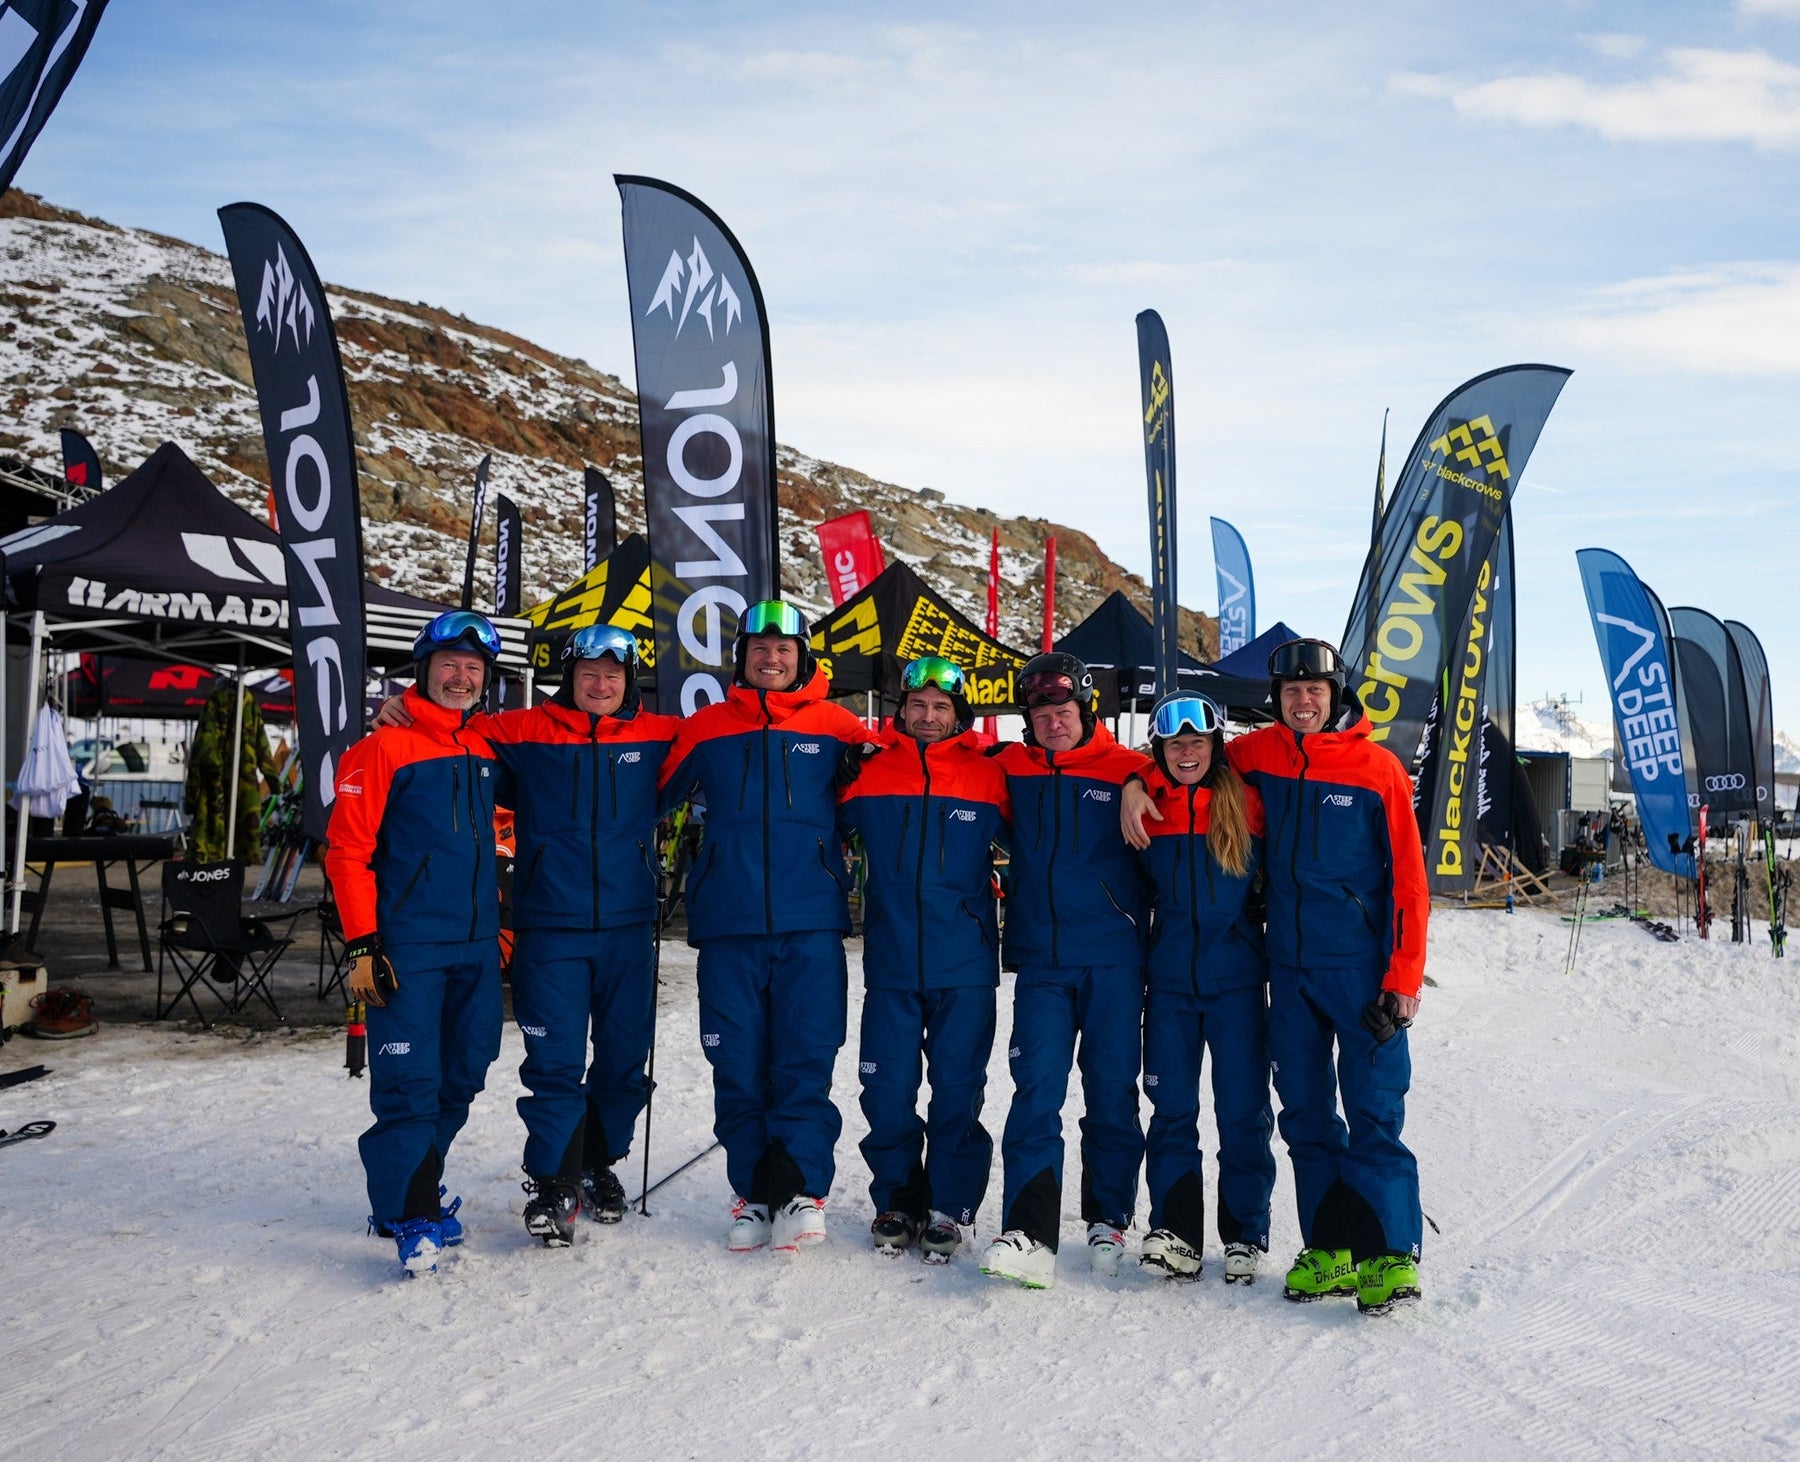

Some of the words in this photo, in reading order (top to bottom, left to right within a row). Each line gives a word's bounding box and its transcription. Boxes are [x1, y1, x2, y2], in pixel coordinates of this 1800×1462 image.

[1436, 465, 1503, 501] blackcrows
[1436, 559, 1492, 877] blackcrows
[1617, 688, 1660, 782] DEEP
[1637, 661, 1683, 776] STEEP
[1170, 1244, 1200, 1261] HEAD
